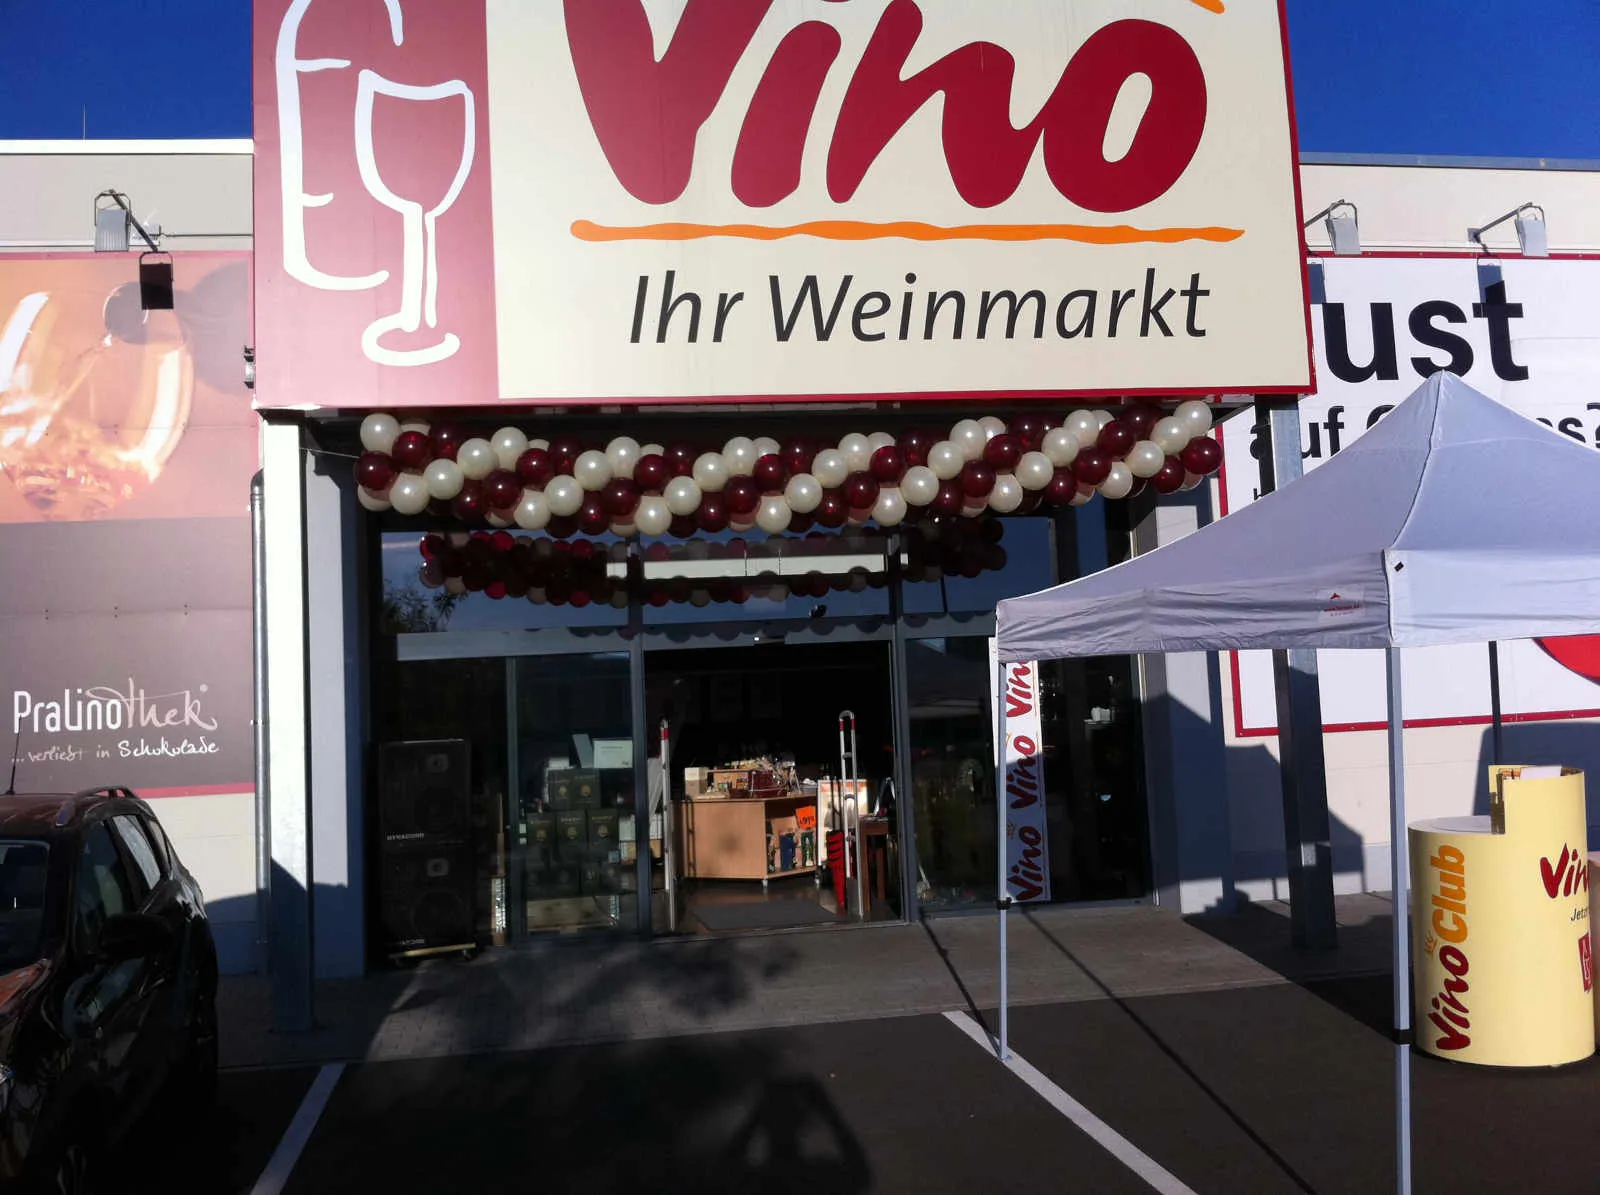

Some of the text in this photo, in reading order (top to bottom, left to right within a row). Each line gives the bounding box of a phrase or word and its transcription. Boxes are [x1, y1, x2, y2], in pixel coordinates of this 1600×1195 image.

[563, 0, 1208, 213] Vino
[629, 267, 1211, 344] Ihr Weinmarkt
[1321, 280, 1529, 383] ust
[1006, 660, 1032, 718] Vin
[96, 744, 110, 759] in
[117, 736, 220, 758] Schokolade
[1006, 735, 1038, 810] Vino
[1008, 826, 1044, 901] Vino
[1539, 842, 1590, 899] Vin
